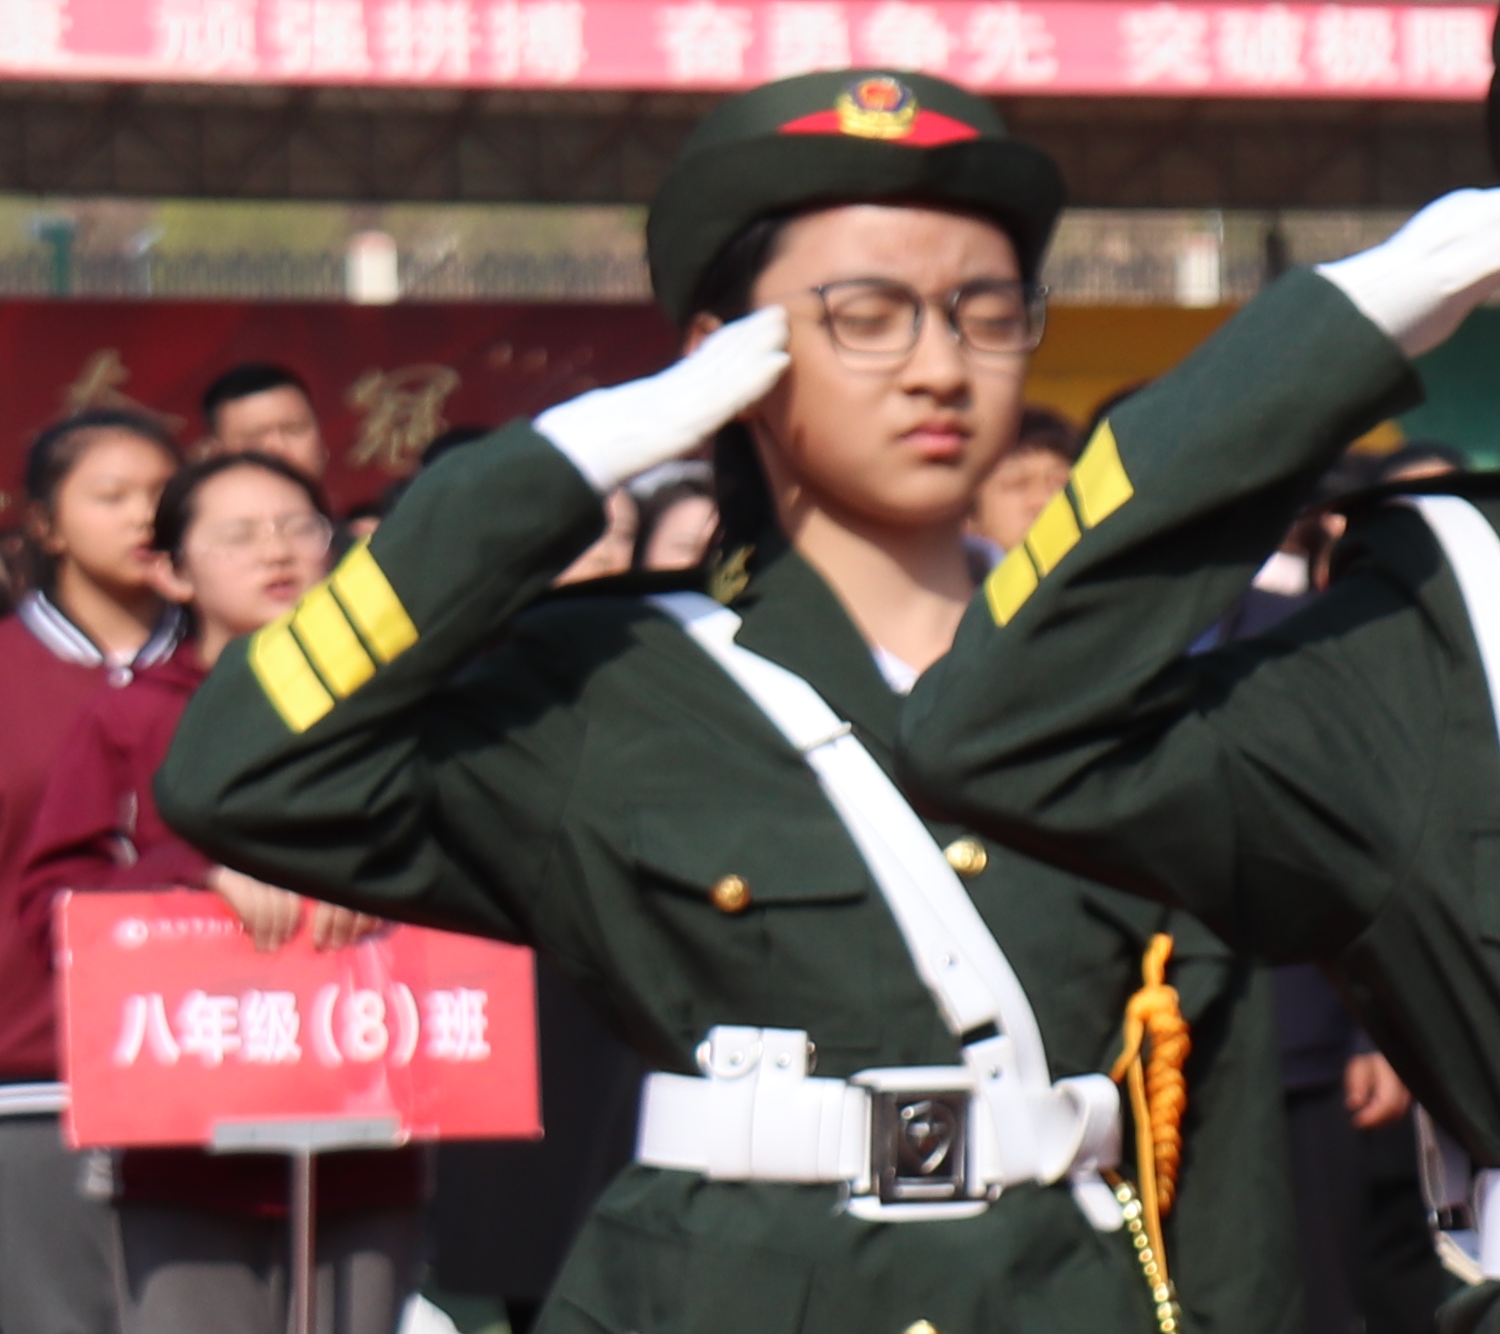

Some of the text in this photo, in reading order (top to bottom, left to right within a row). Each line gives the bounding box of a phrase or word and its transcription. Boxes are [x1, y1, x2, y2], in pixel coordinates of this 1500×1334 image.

[1120, 2, 1493, 87] 突破极限
[113, 983, 491, 1067] 八年级(8)班
